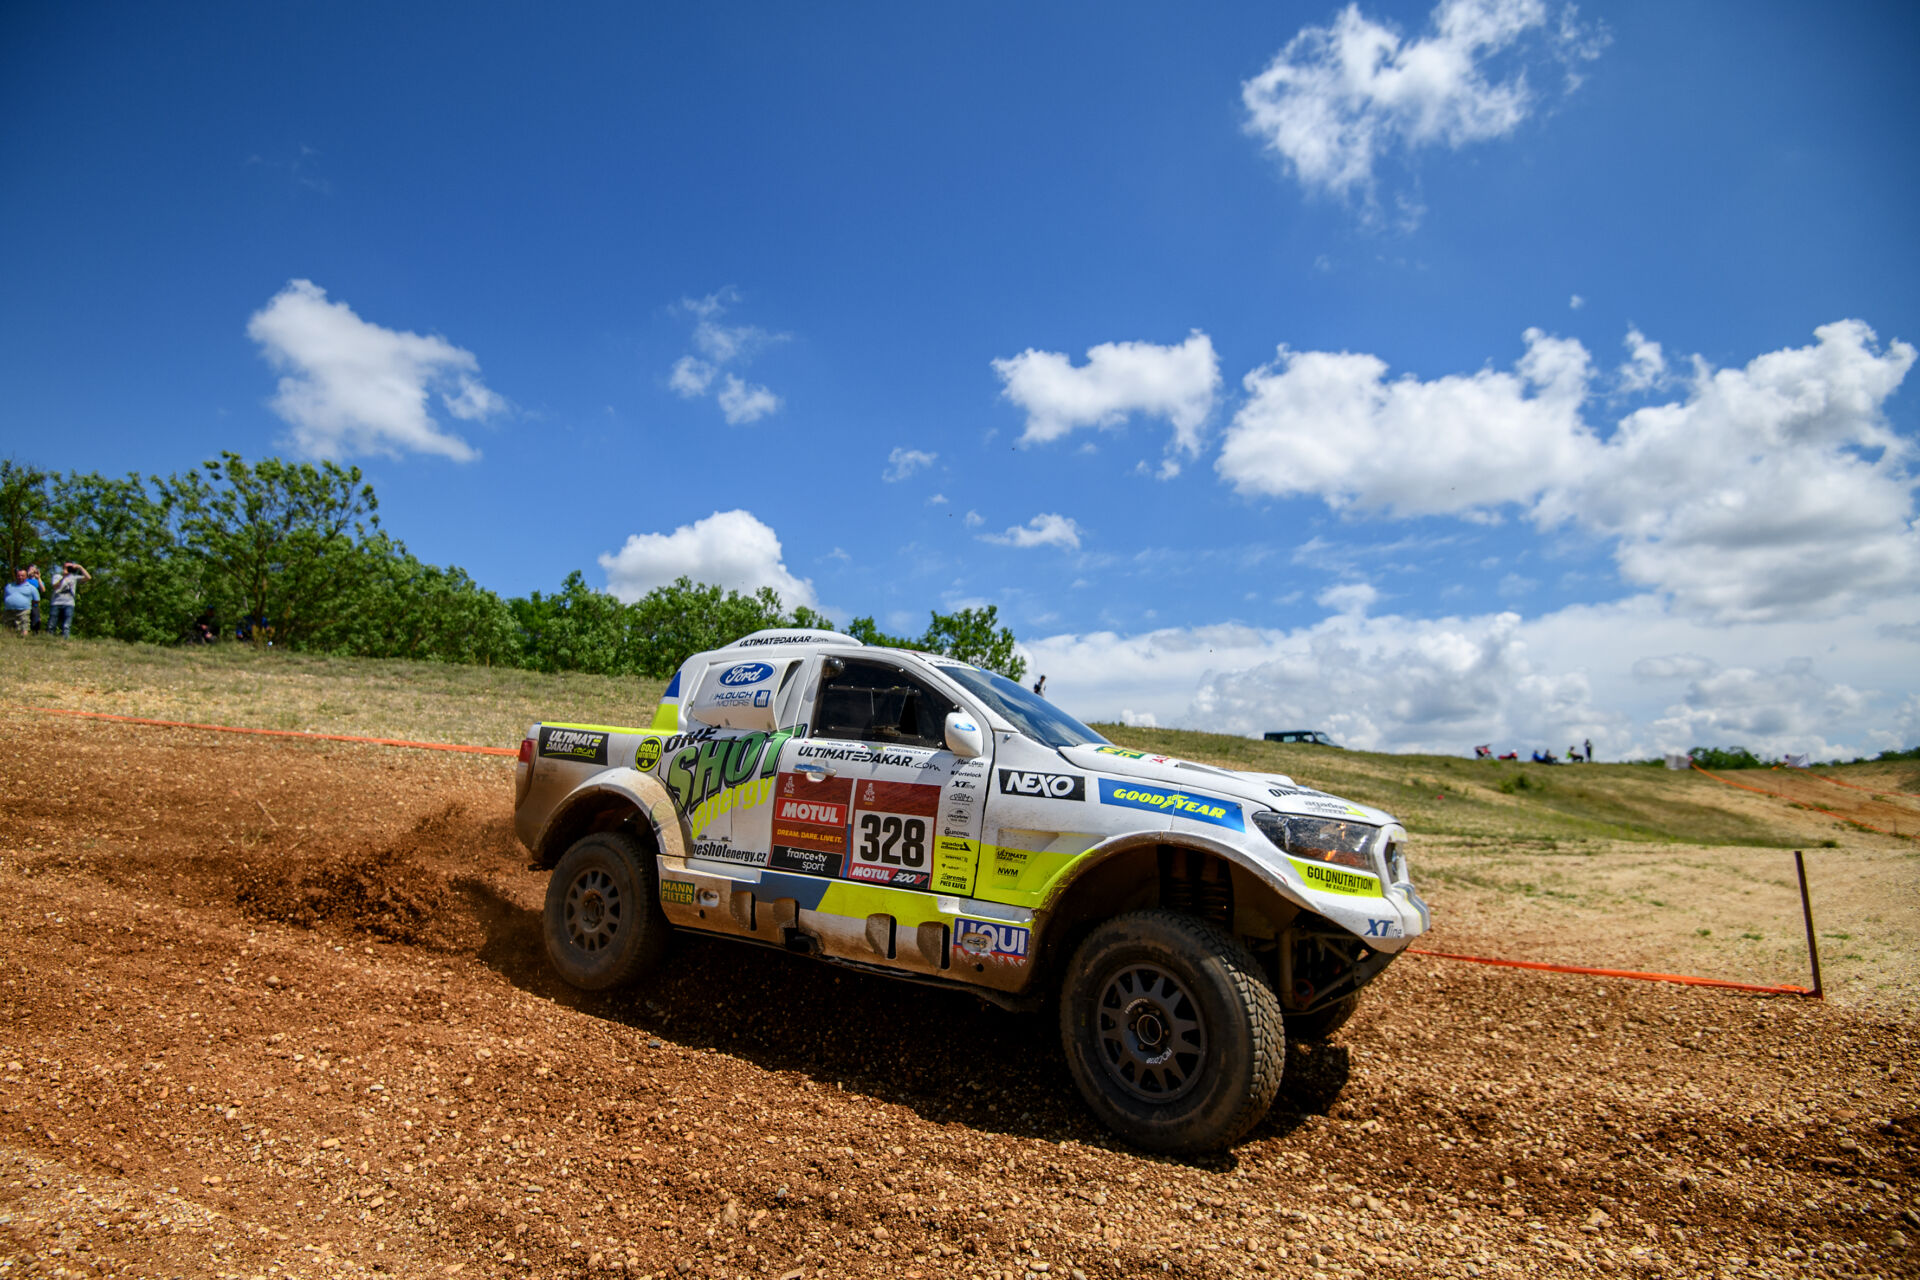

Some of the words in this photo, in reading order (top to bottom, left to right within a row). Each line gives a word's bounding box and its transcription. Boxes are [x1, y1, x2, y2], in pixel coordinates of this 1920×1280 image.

[725, 664, 764, 683] Ford
[716, 699, 750, 707] MOTORS
[546, 741, 574, 753] DAKAR
[549, 730, 603, 747] ULTIMATE
[664, 725, 717, 752] ONE
[640, 743, 659, 753] GOLD
[667, 723, 807, 815] SHOT
[1006, 772, 1075, 797] NEXO
[691, 776, 773, 840] energy
[781, 801, 839, 823] MOTUL
[1113, 788, 1226, 819] GOODYEAR
[820, 834, 834, 842] LIVE
[860, 814, 925, 867] 328
[998, 850, 1028, 860] ULTIMATE
[802, 861, 825, 871] sport
[852, 866, 890, 881] MOTUL
[893, 873, 928, 884] 300V
[998, 867, 1019, 877] NWM
[662, 881, 694, 894] MANN
[1307, 866, 1373, 891] GOLDNUTRITION
[662, 890, 693, 904] FILTER
[1364, 918, 1402, 938] XTline
